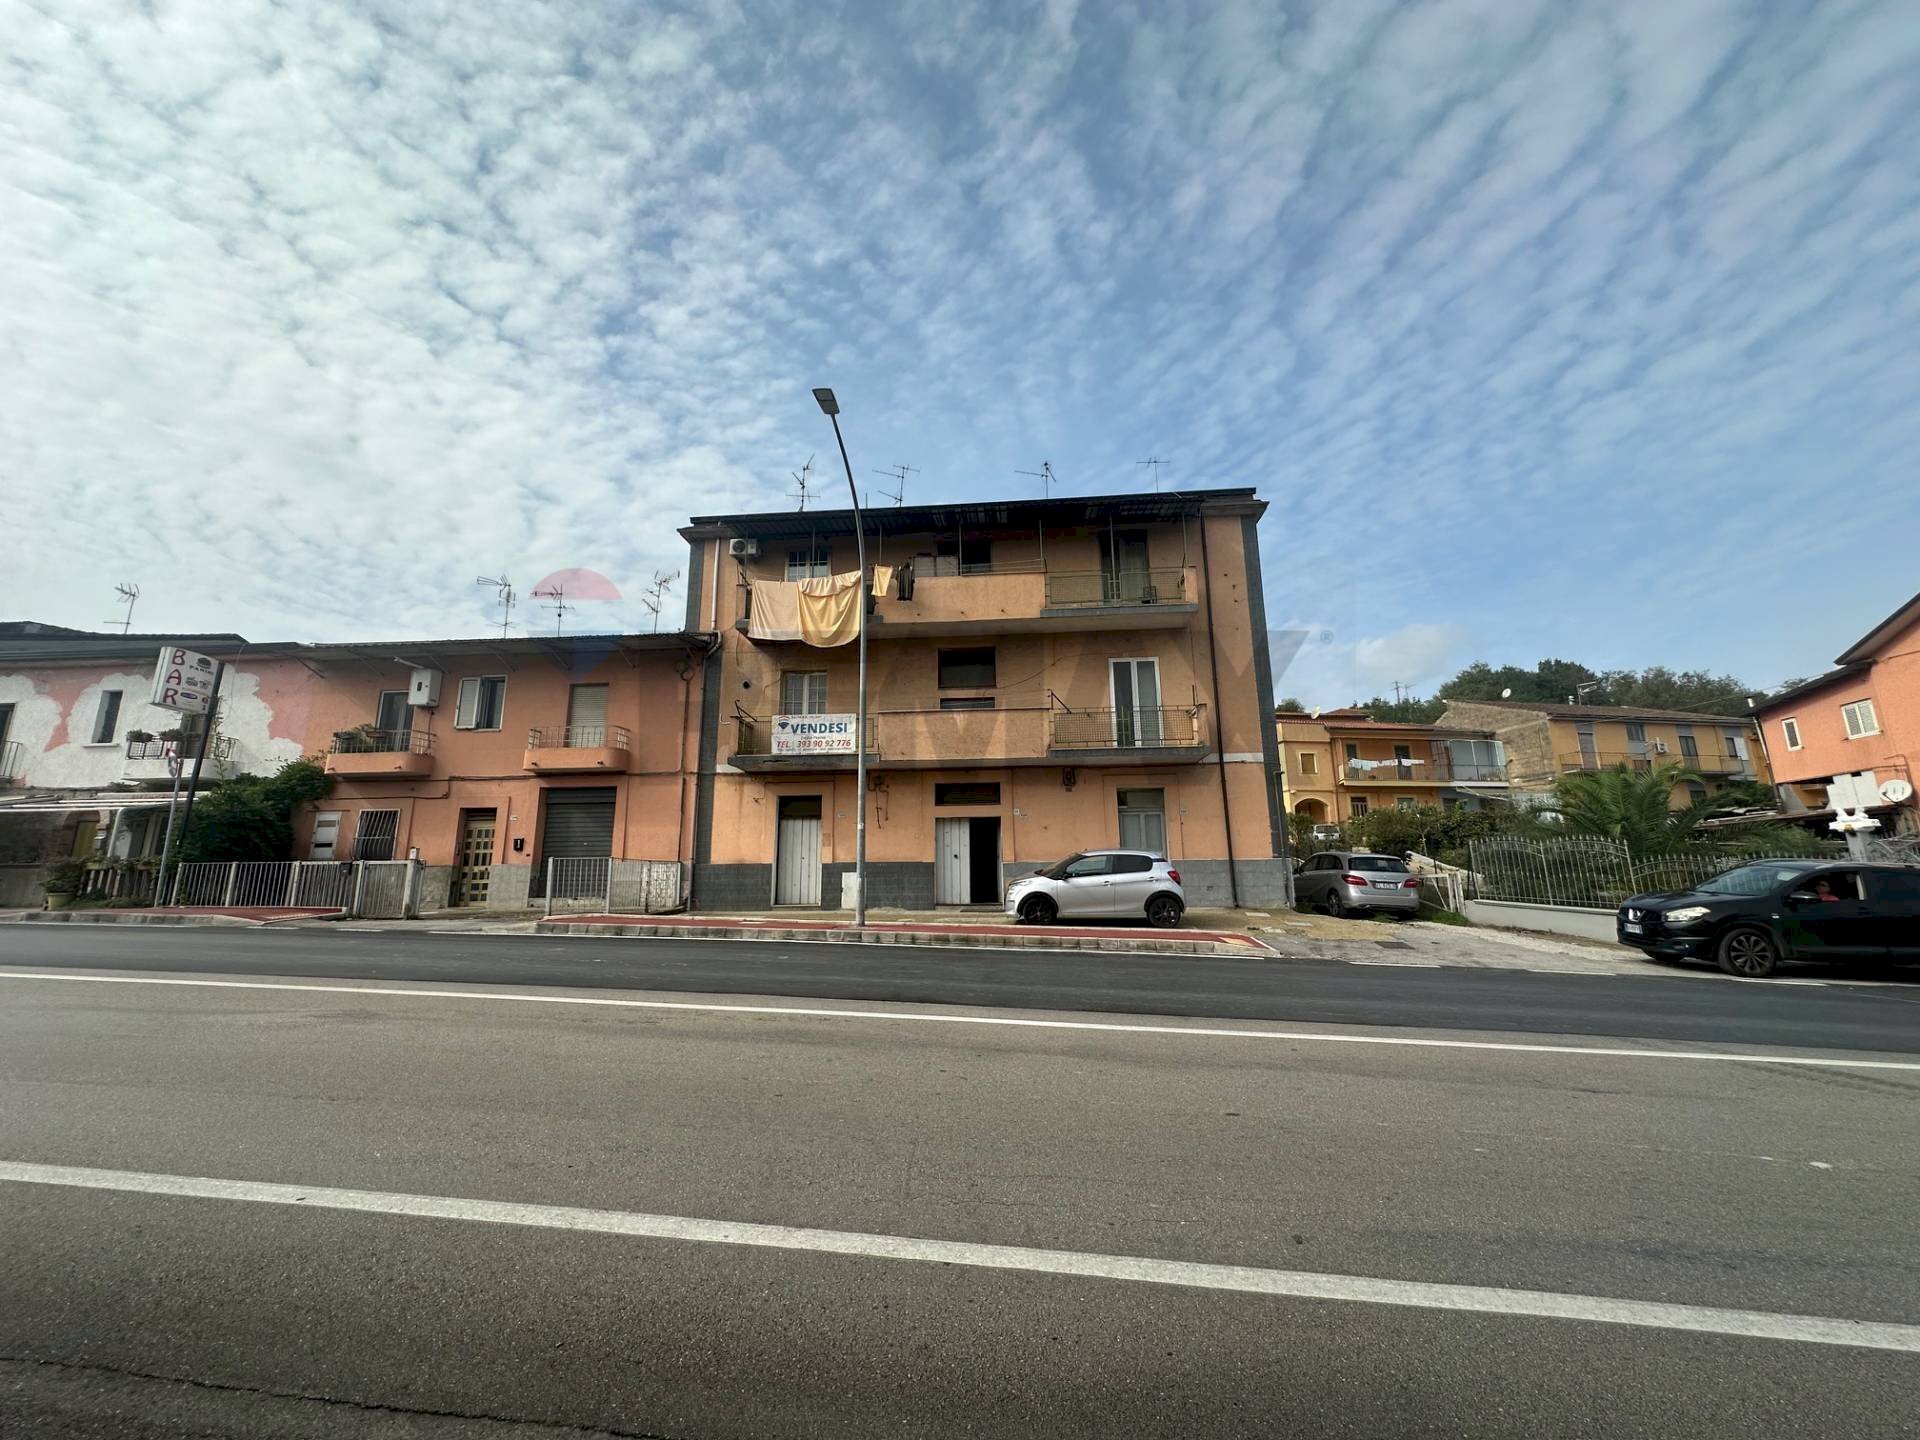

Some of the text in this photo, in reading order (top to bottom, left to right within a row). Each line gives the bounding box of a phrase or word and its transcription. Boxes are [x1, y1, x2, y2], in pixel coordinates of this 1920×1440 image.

[166, 649, 186, 705] BAR
[791, 723, 848, 735] VENDESI
[813, 740, 823, 748] 90
[825, 740, 835, 748] 92
